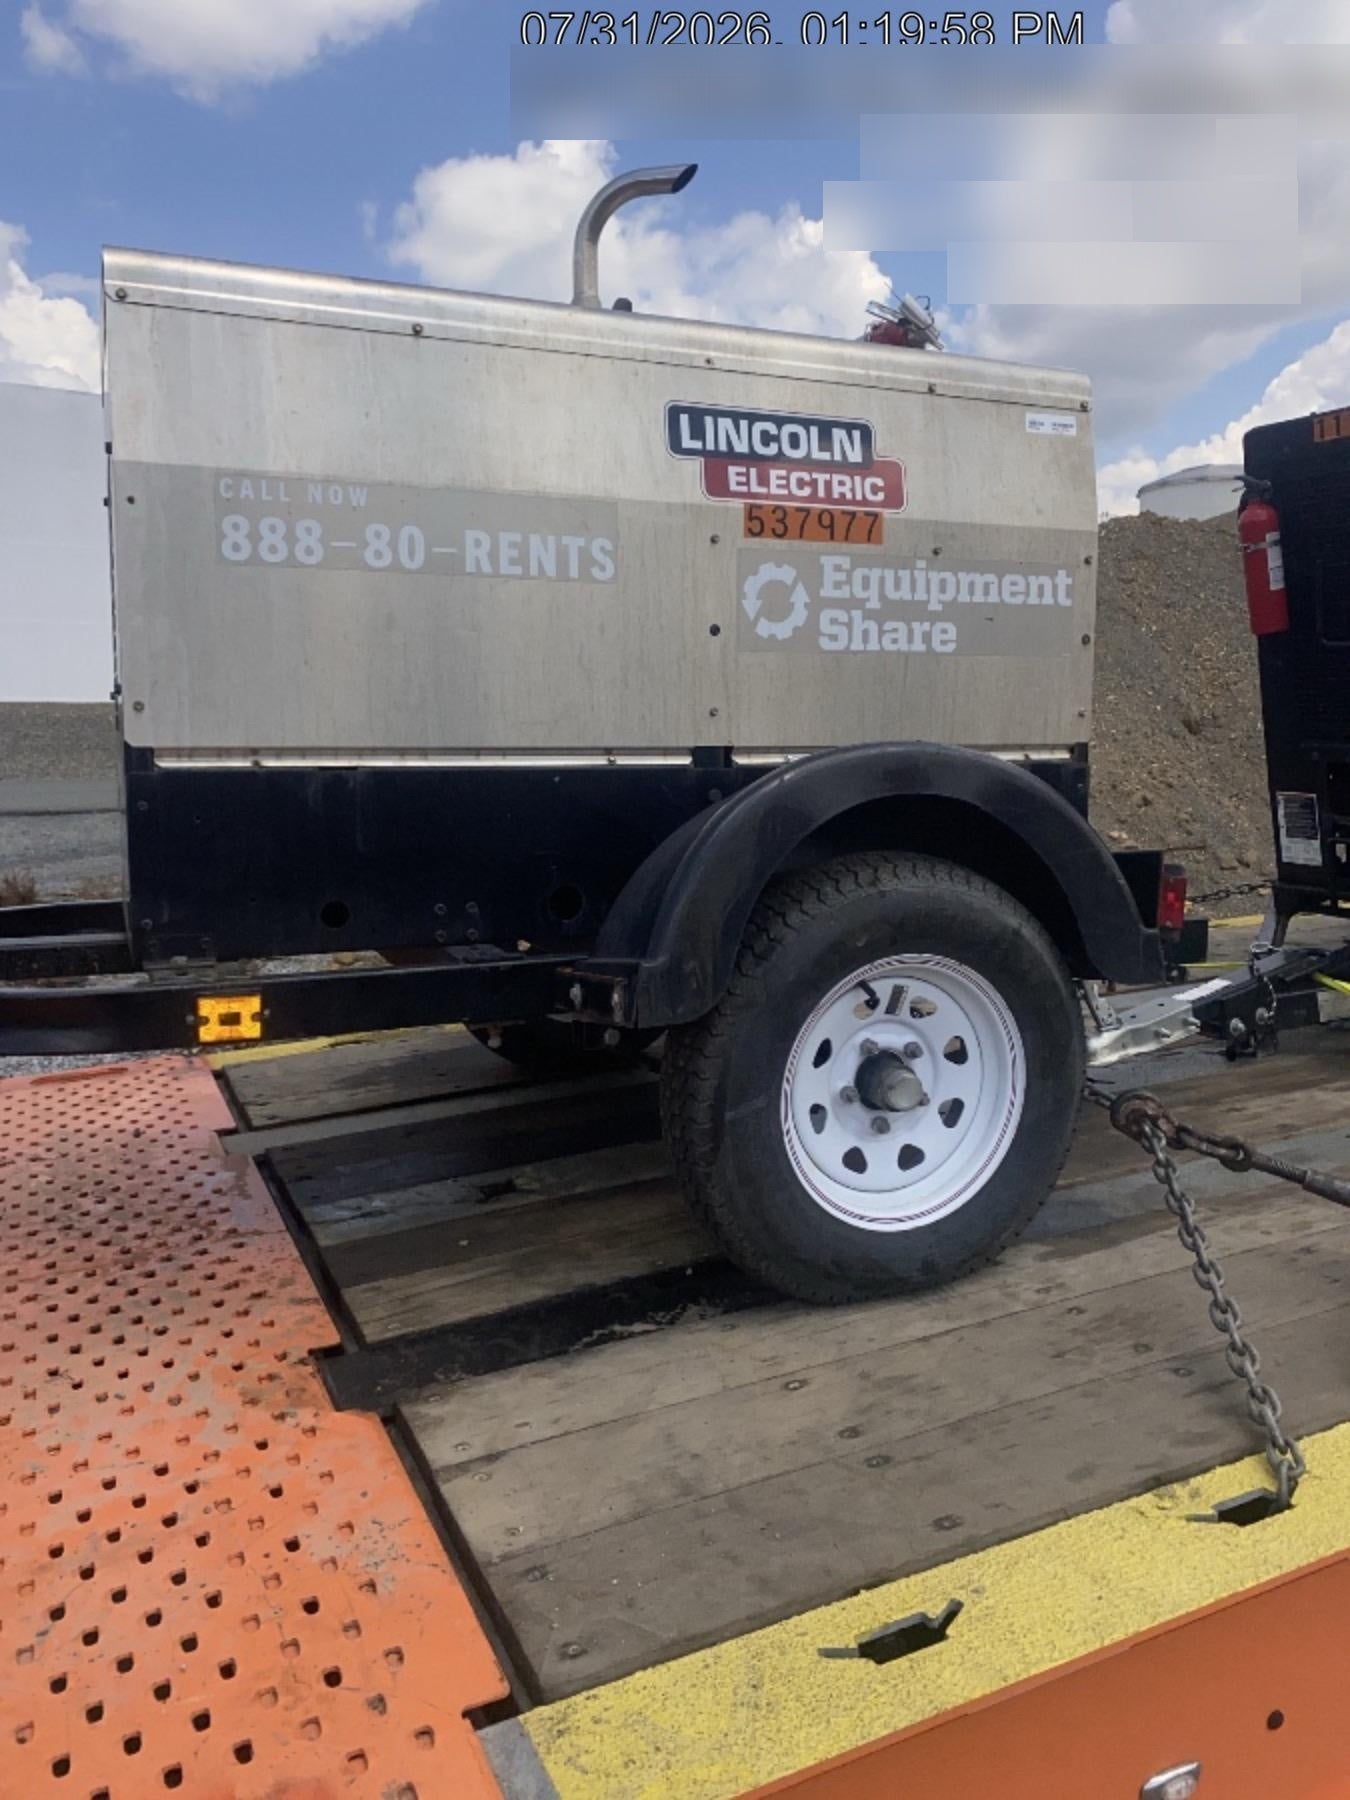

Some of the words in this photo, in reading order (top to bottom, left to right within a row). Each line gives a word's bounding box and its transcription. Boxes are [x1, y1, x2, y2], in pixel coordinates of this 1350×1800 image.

[679, 412, 863, 464] LINCOLN
[219, 477, 291, 501] CALL
[307, 484, 368, 507] NOW
[728, 465, 885, 501] ELECTRIC
[747, 503, 880, 543] 537977
[220, 514, 616, 581] 888-80-RENTS
[819, 555, 1073, 611] Equipment
[818, 608, 958, 652] Share
